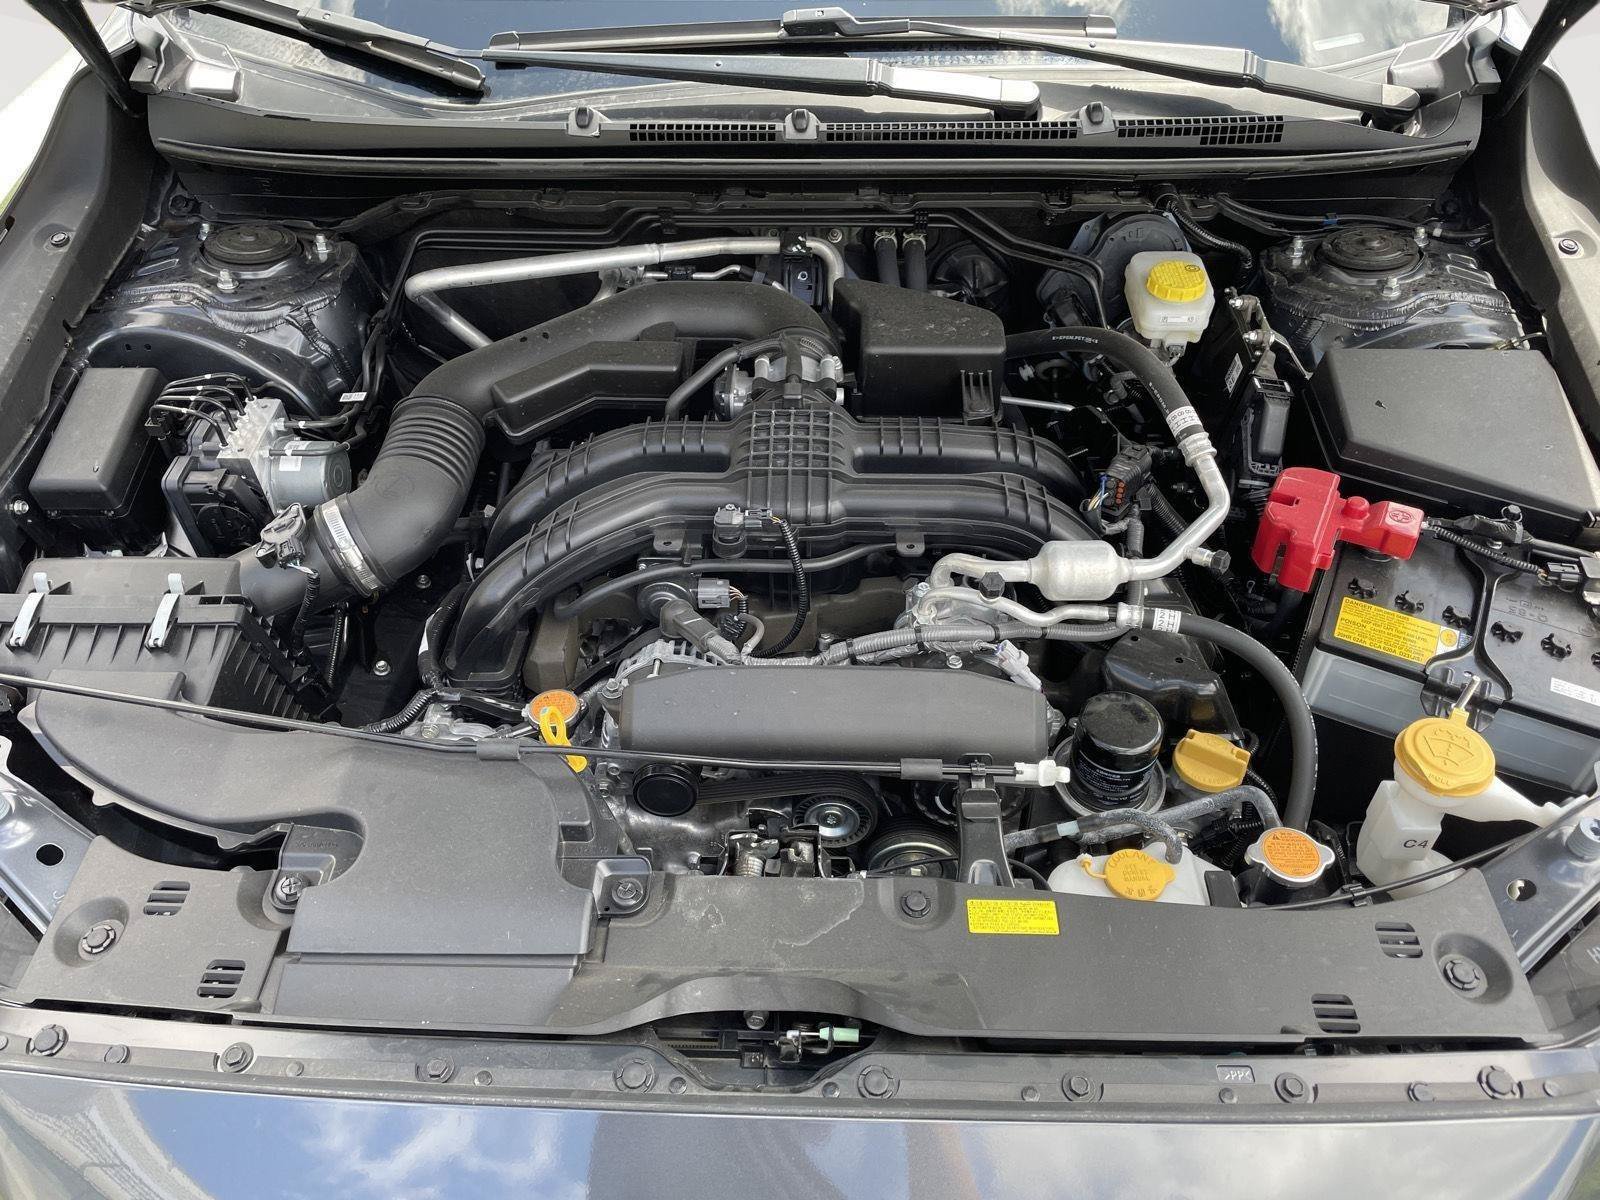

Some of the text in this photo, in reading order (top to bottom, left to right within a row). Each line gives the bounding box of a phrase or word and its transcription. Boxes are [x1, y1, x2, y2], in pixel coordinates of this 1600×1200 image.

[1344, 598, 1372, 610] DANGER
[1339, 617, 1367, 629] POISON
[1403, 839, 1429, 849] C4
